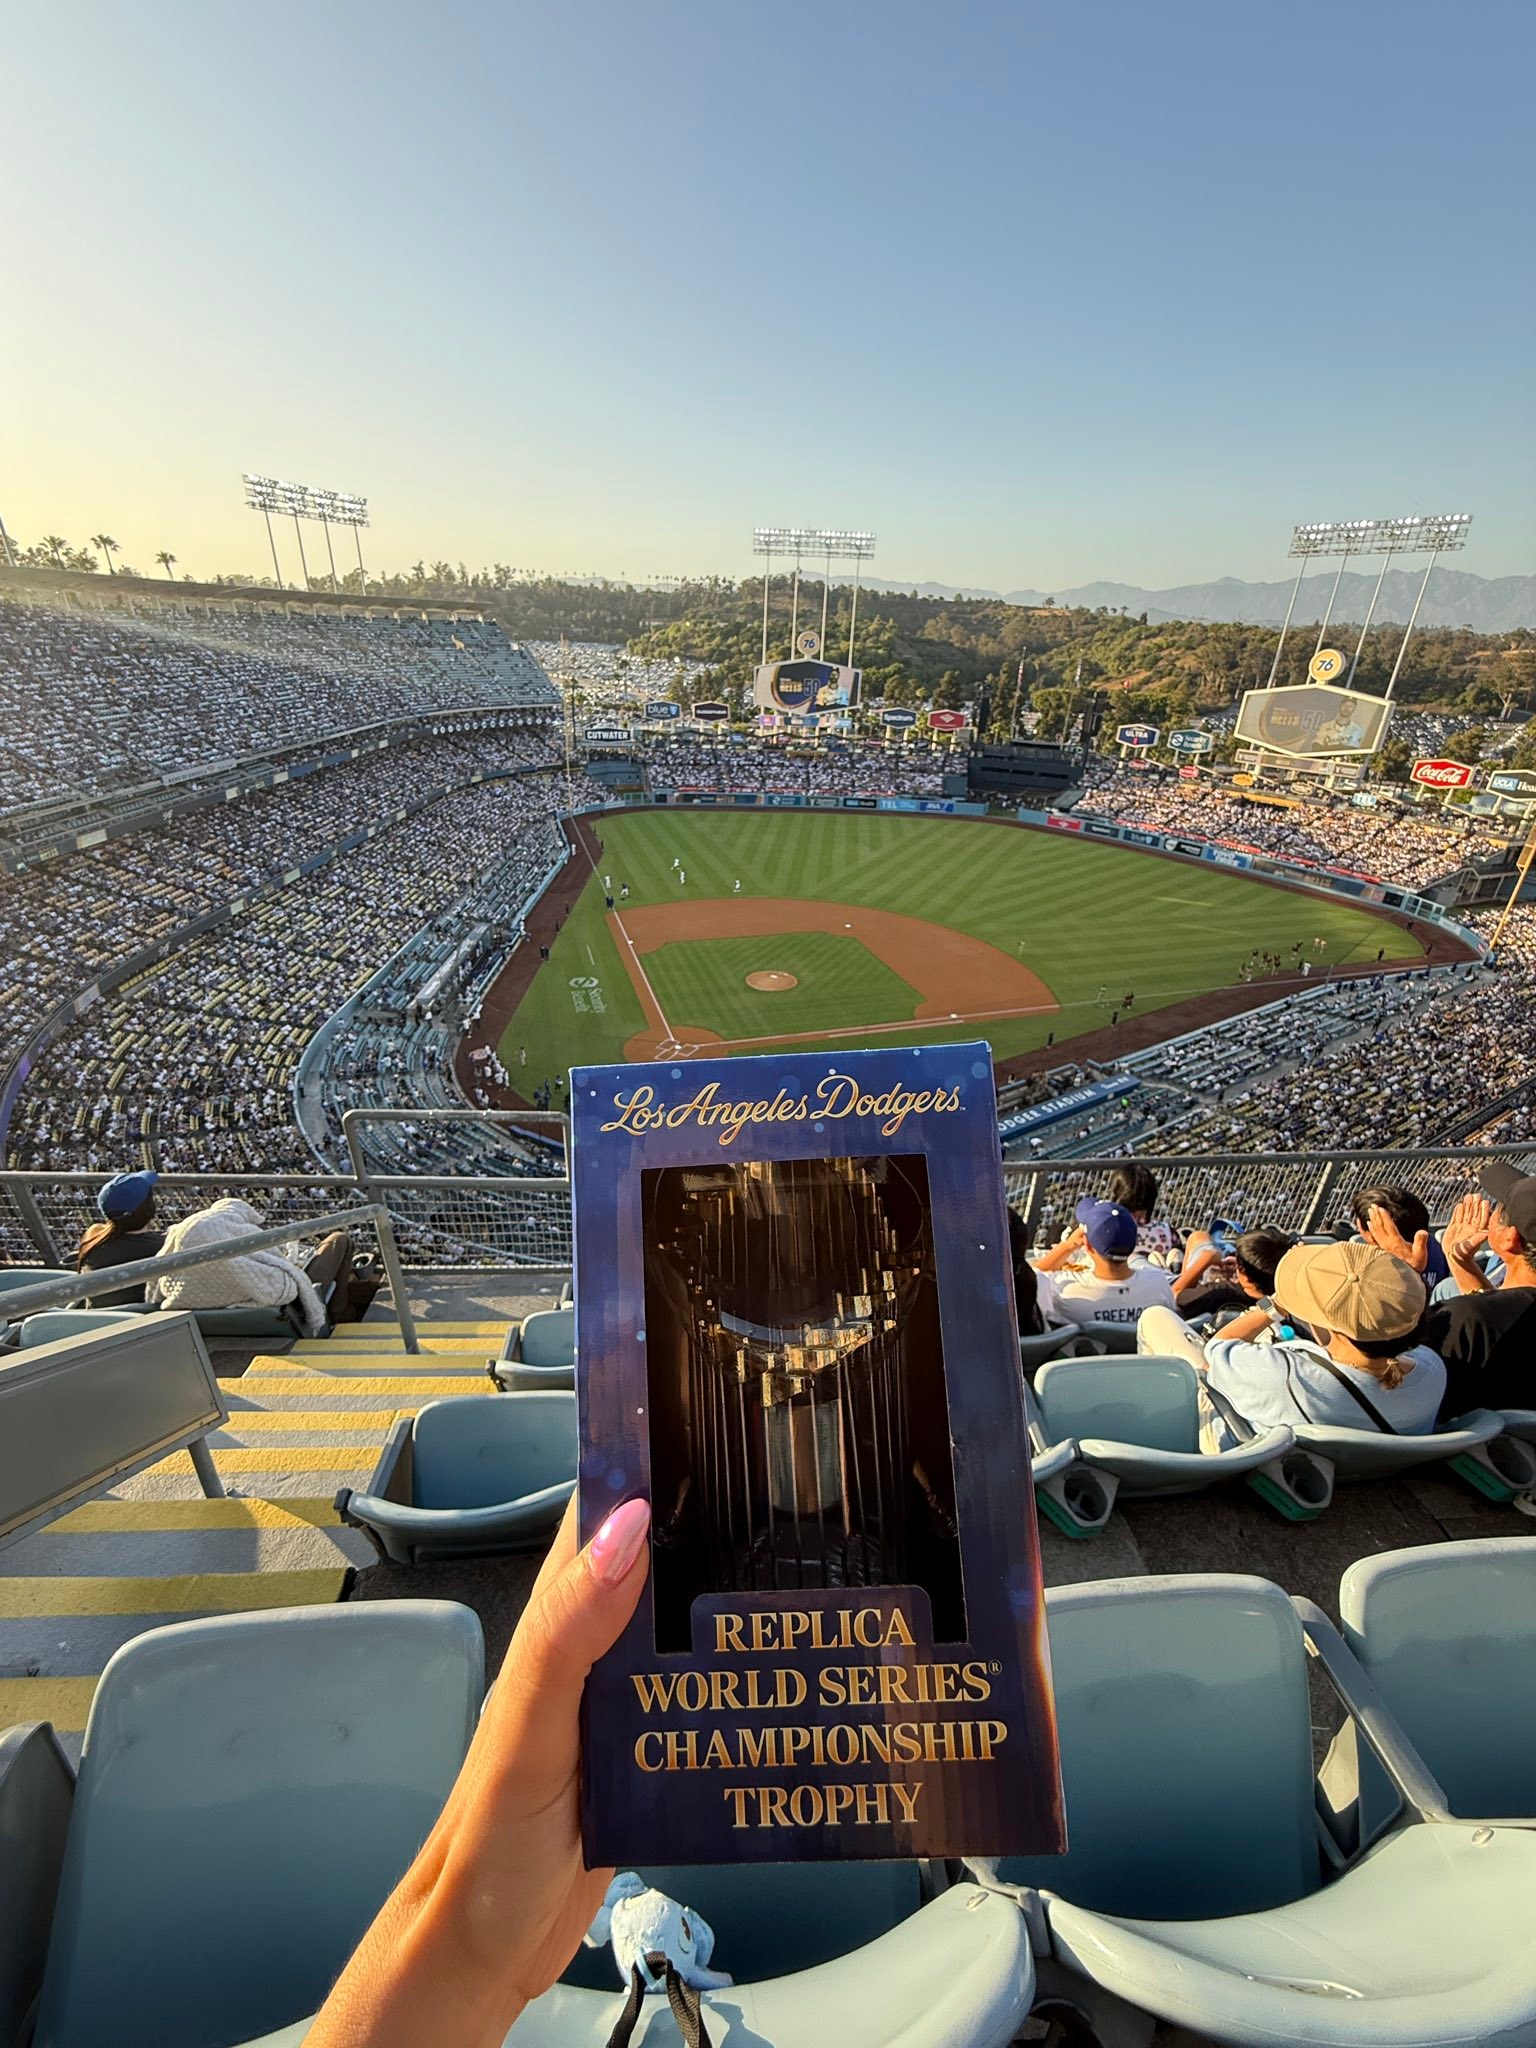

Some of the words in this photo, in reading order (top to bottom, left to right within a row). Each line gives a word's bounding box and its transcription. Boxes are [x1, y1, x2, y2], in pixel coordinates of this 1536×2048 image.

[803, 639, 815, 648] 76
[1316, 659, 1334, 672] 76
[648, 705, 669, 714] blue
[586, 730, 629, 740] CUTWATER
[1125, 730, 1148, 739] ULTRA
[1494, 777, 1515, 788] UCLA
[882, 800, 897, 810] TEL
[1041, 1088, 1097, 1113] STADIUM
[600, 1086, 664, 1136] Los
[665, 1082, 811, 1146] Angeles
[713, 1607, 916, 1653] REPLICA
[629, 1669, 808, 1713] WORLD
[634, 1720, 1008, 1772] CHAMPIONSHIP
[724, 1782, 923, 1828] TROPHY
